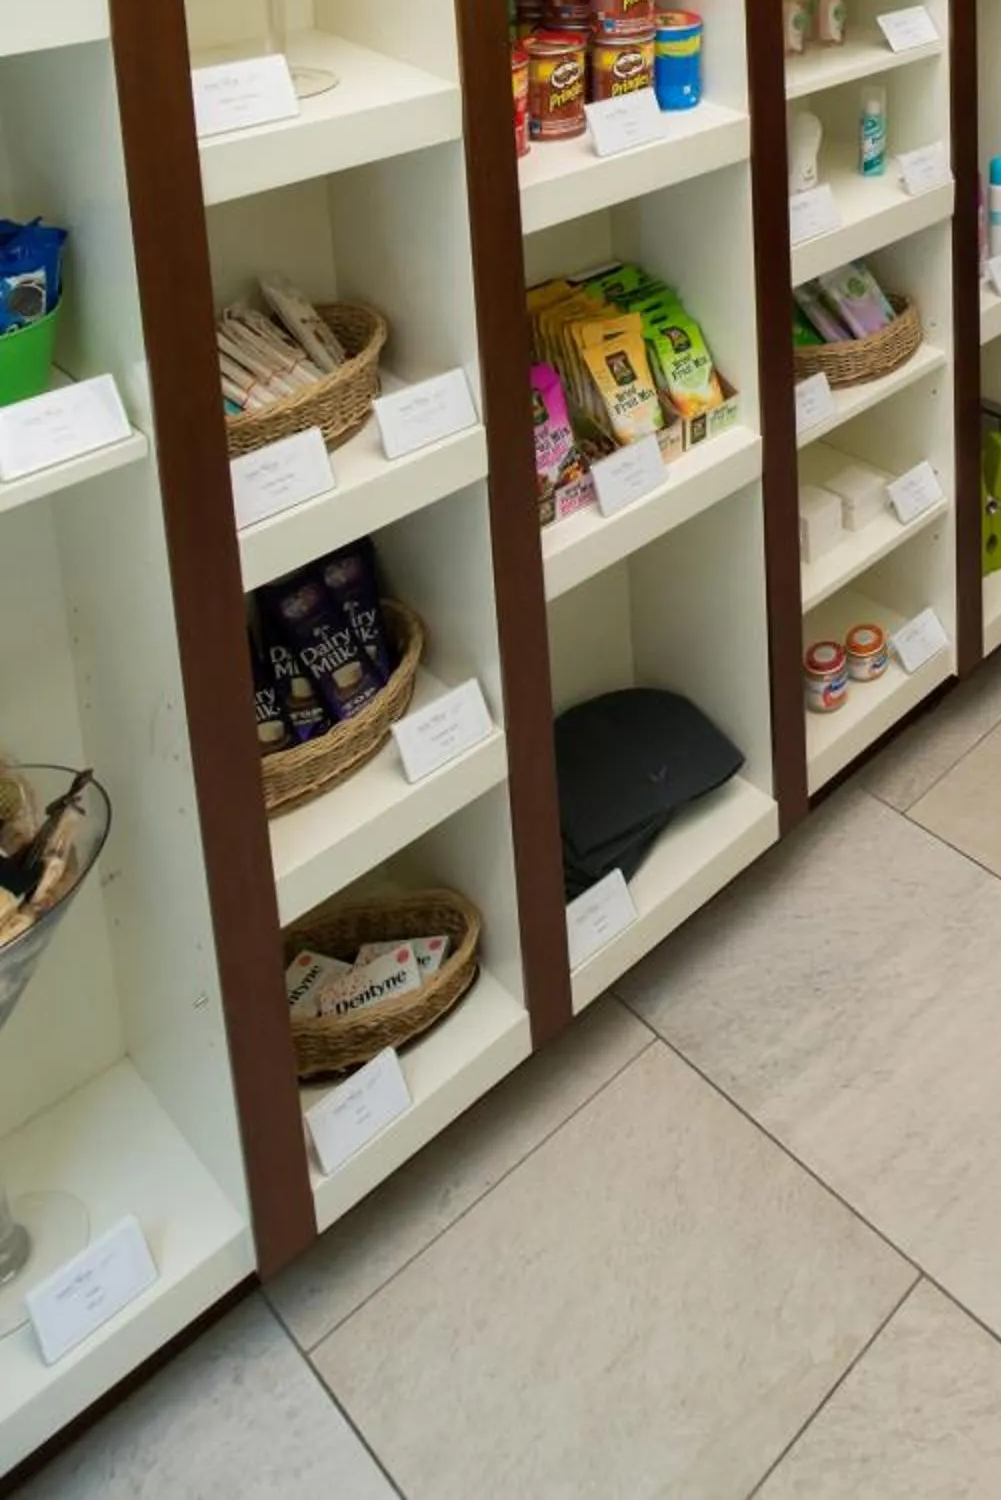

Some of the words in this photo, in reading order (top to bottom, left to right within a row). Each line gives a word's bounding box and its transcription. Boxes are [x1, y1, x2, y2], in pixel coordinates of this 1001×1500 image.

[300, 627, 351, 667] Dairy
[309, 646, 355, 680] Milk
[334, 969, 408, 1016] Dentyne
